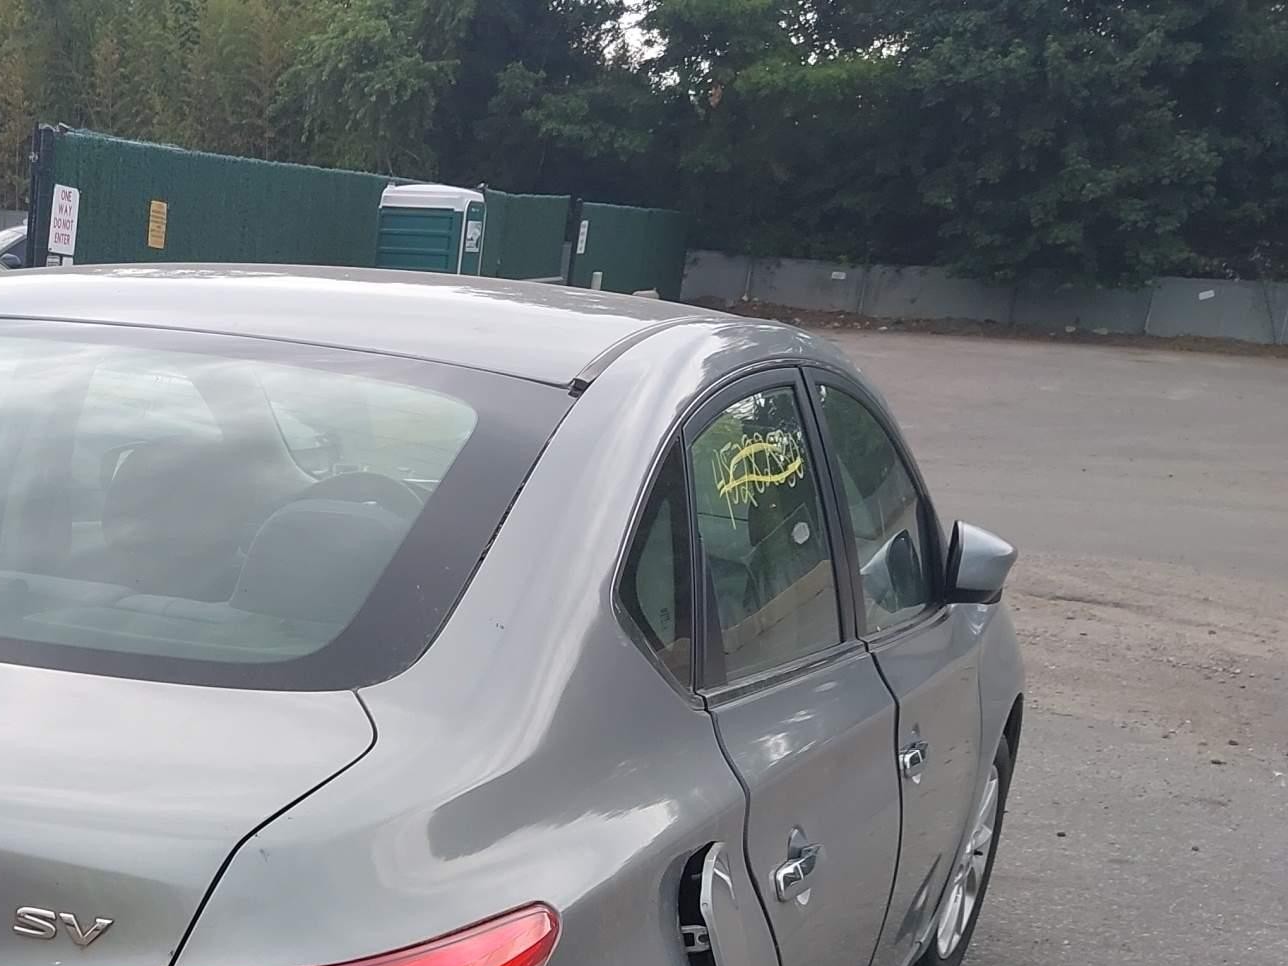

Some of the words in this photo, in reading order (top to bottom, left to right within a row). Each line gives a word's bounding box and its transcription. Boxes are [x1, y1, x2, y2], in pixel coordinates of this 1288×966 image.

[61, 190, 72, 202] ONE
[58, 204, 73, 216] WAY
[53, 218, 62, 228] DO
[62, 219, 73, 231] NOT
[54, 233, 70, 245] ENTER
[13, 906, 114, 948] SV
